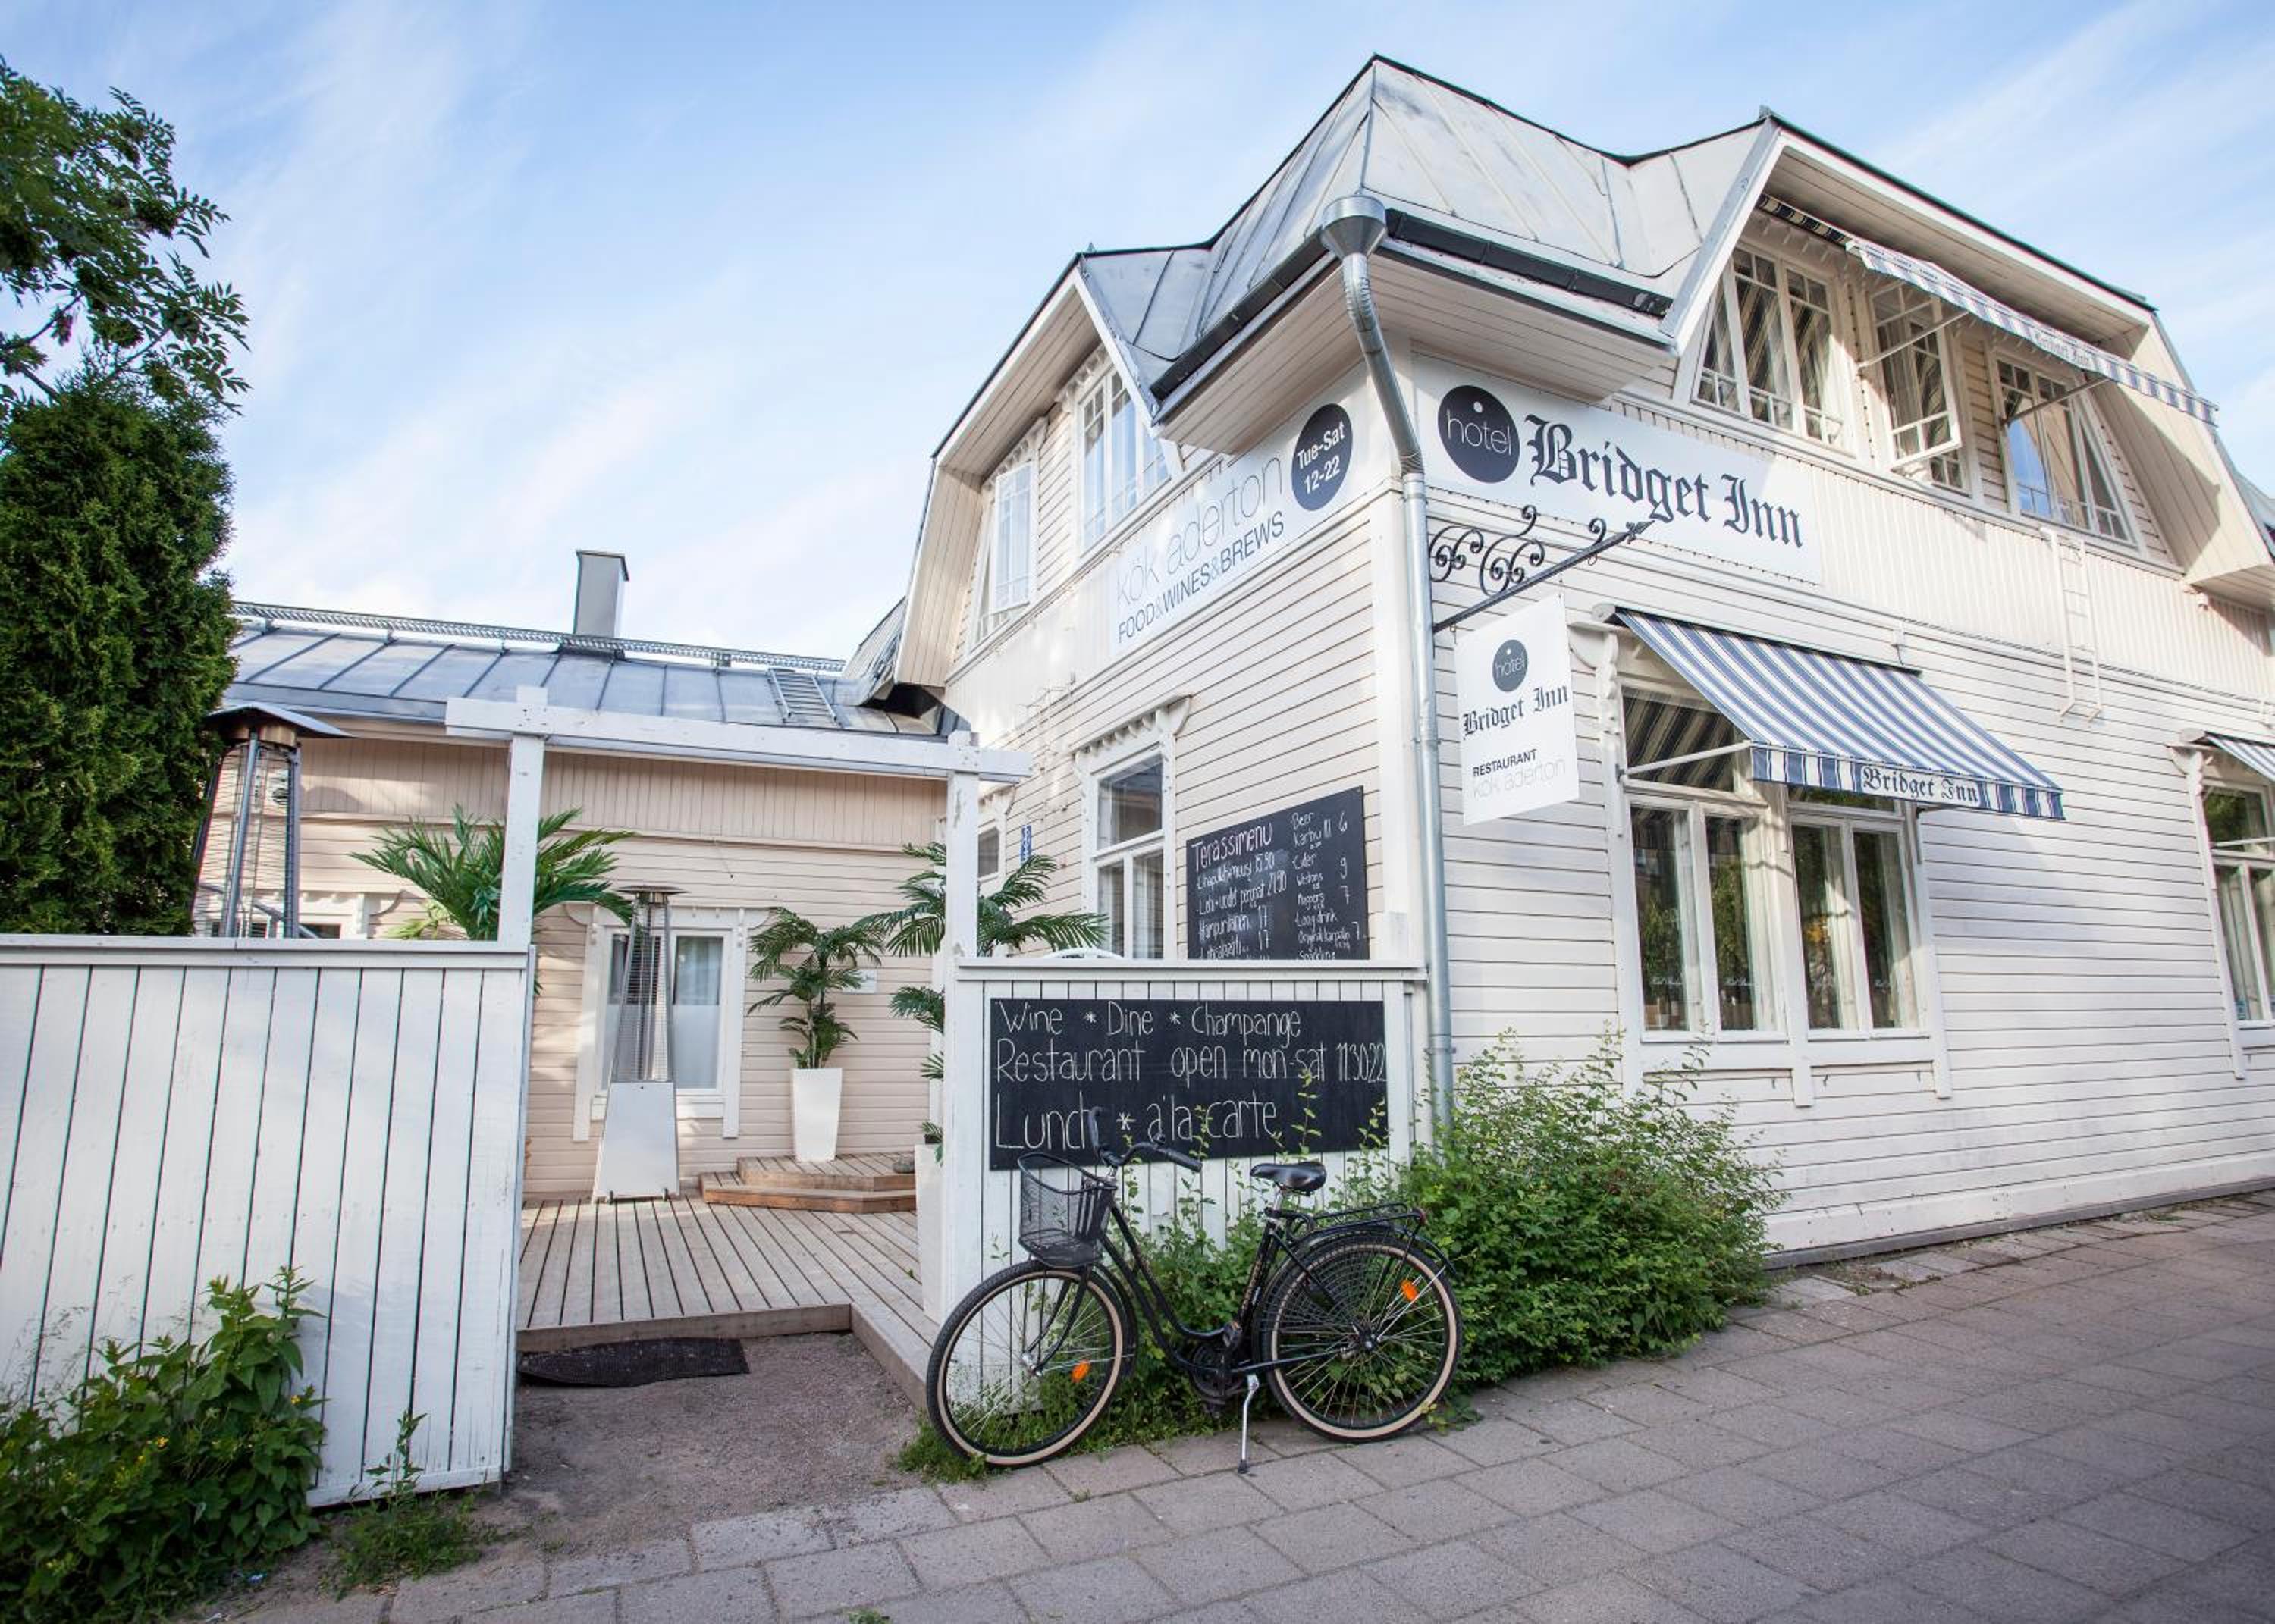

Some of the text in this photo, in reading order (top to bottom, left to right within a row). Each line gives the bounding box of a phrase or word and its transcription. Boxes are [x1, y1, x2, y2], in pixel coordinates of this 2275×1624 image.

[1298, 421, 1346, 470] Tue-Sat
[1445, 409, 1511, 456] hotel
[1304, 455, 1340, 494] 12-22
[1525, 414, 1803, 548] Bridget Inn
[1168, 458, 1282, 575] aderton
[1495, 654, 1526, 679] hotel
[1463, 685, 1568, 740] Bridget Inn
[1473, 749, 1537, 777] RESTAURANT
[1862, 766, 1978, 802] Bridget Inn
[995, 1000, 1301, 1048] Wine Dine Champange
[996, 1038, 1147, 1083] Restaurant
[1172, 1045, 1228, 1089] open
[1205, 1089, 1278, 1139] carte
